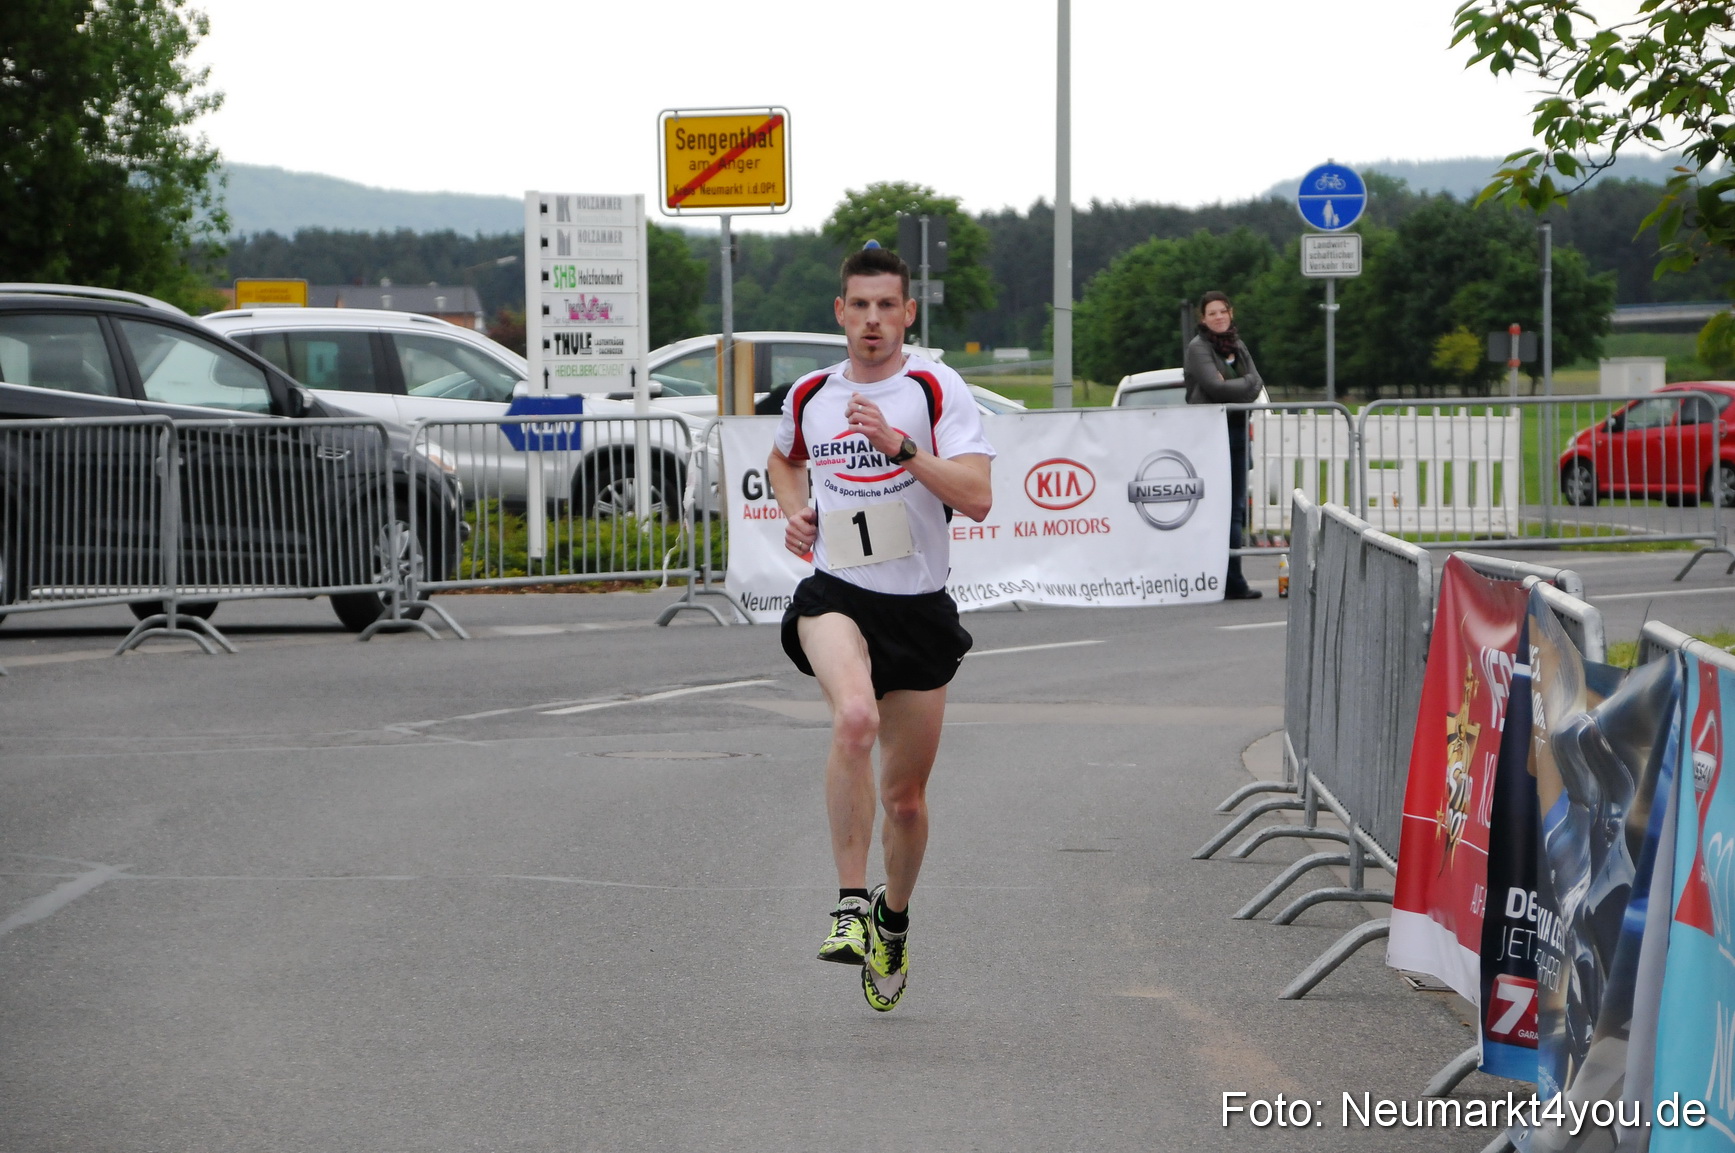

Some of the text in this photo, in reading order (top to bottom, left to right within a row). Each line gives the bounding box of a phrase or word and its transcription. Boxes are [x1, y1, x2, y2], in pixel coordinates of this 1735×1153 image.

[675, 126, 774, 156] Sengenthal
[689, 156, 761, 173] am Anger
[700, 183, 743, 195] Neumarkt
[577, 196, 622, 210] HOLZAMMER
[577, 229, 623, 243] HOLZAMMER
[554, 264, 577, 288] SHB
[553, 332, 592, 355] THULE
[824, 478, 838, 493] Das
[839, 487, 882, 497] sportliche
[1036, 471, 1083, 498] KIA
[1135, 482, 1198, 499] NISSAN
[851, 511, 873, 557] 1
[952, 525, 1001, 541] EAT
[1014, 517, 1111, 538] KIA MOTORS
[1044, 571, 1219, 601] www.gerhart-jaenig.de
[1490, 982, 1535, 1034] 7
